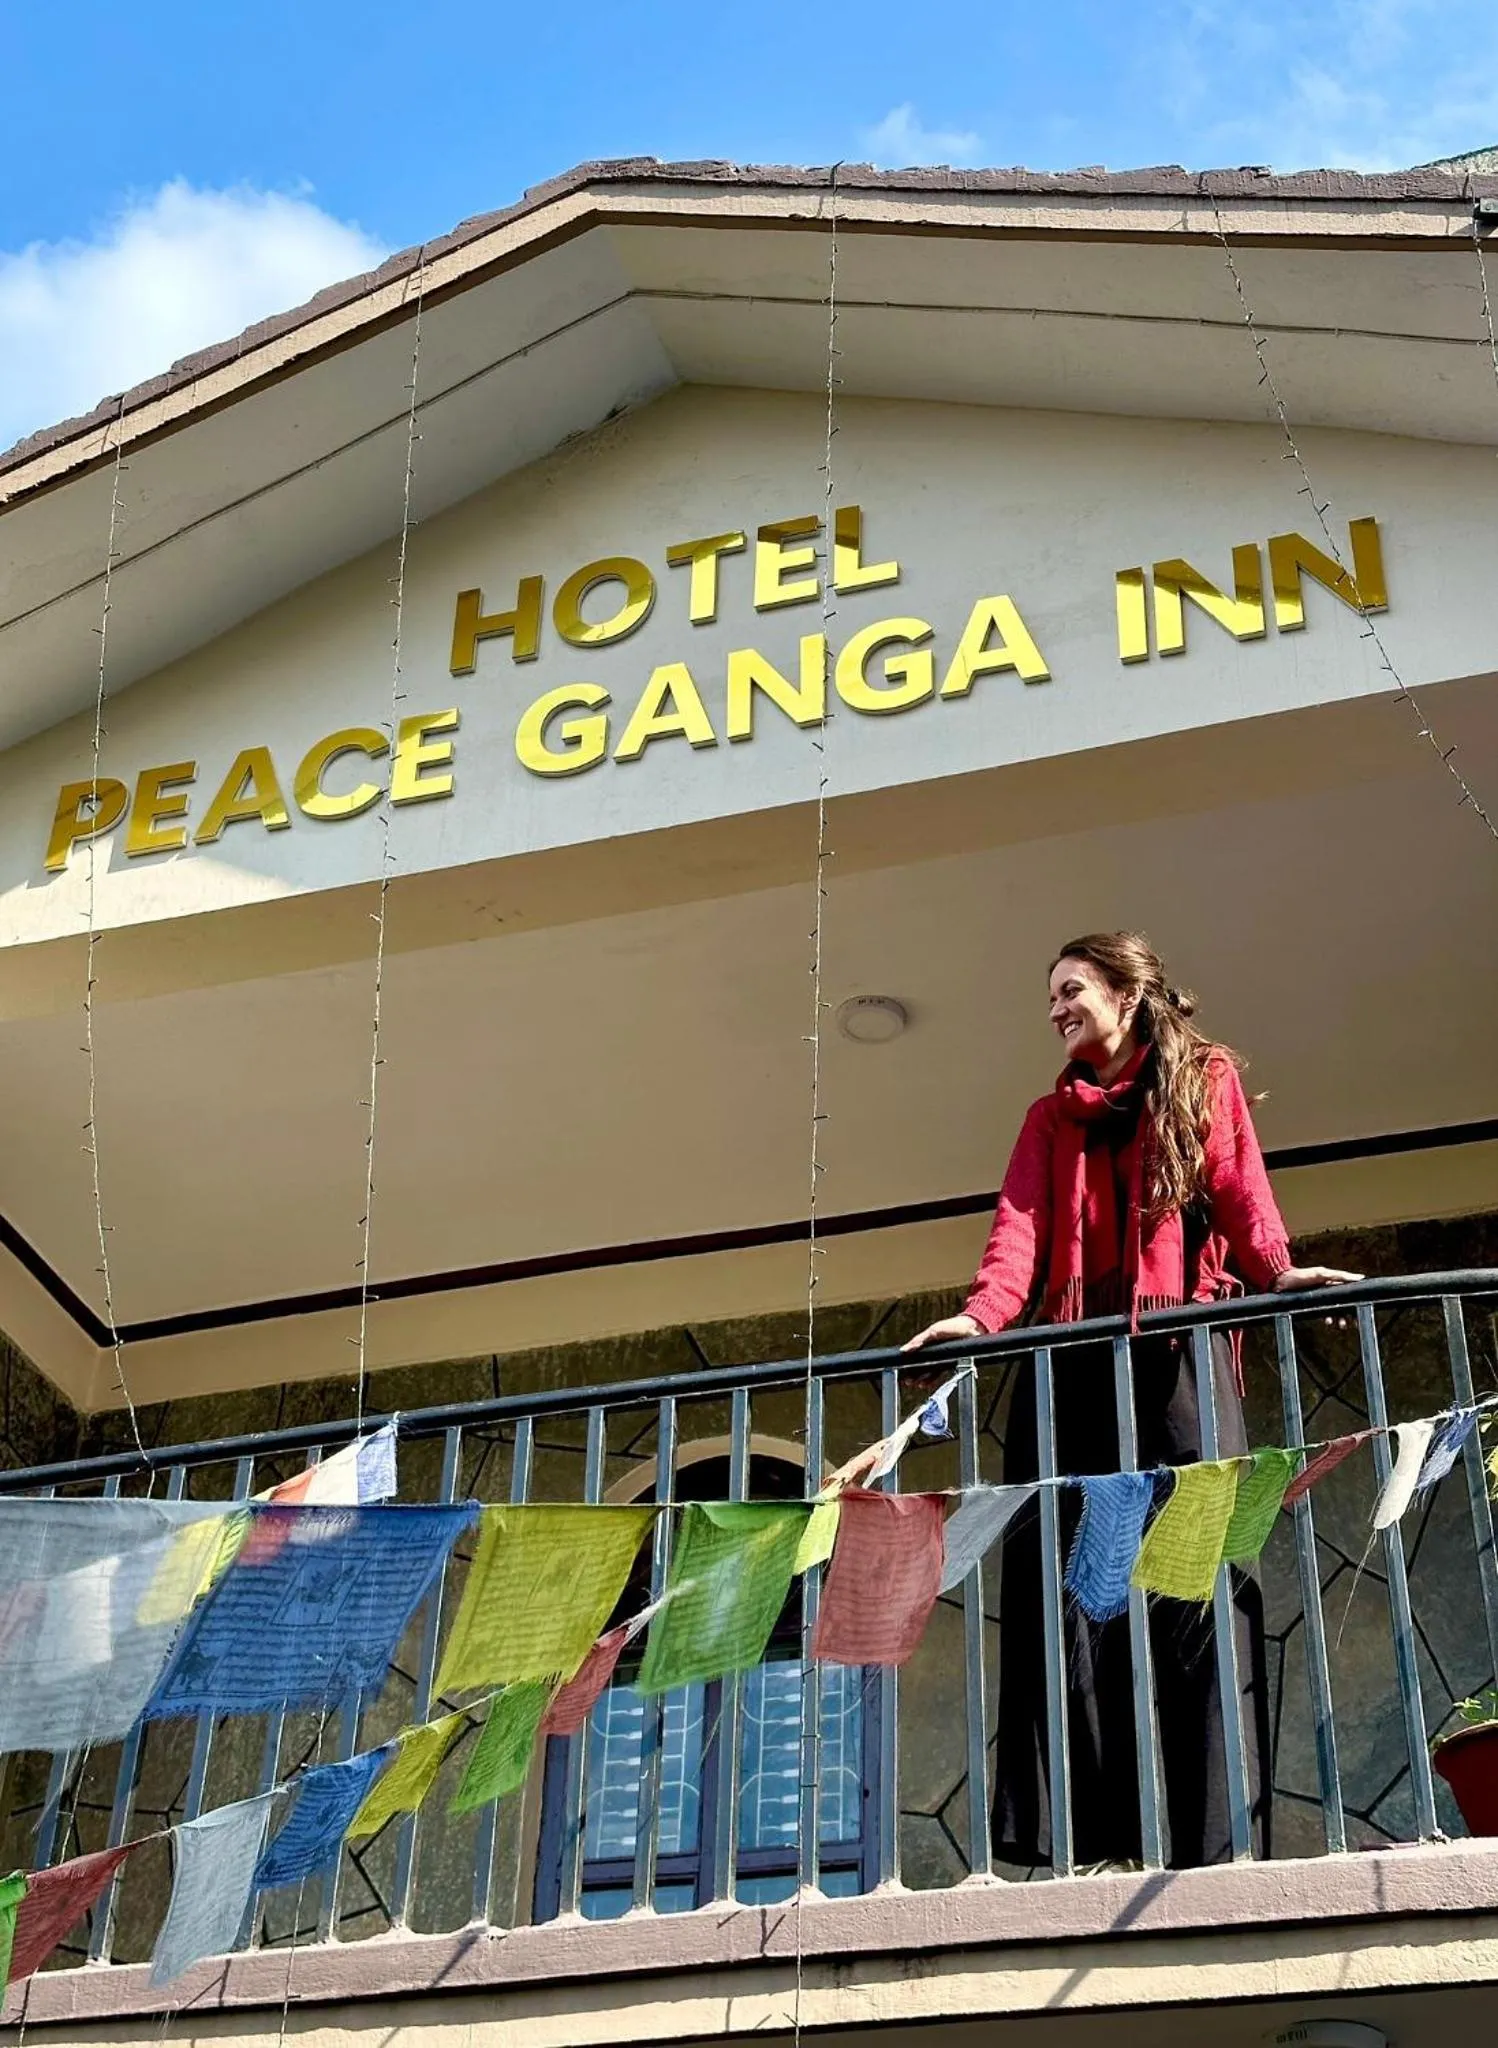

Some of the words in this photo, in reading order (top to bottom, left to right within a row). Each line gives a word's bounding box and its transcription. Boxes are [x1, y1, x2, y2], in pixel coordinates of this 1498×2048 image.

[43, 708, 461, 871] PEACE
[514, 593, 1051, 778] GANGA
[1116, 516, 1387, 664] INN
[450, 505, 900, 675] HOTEL
